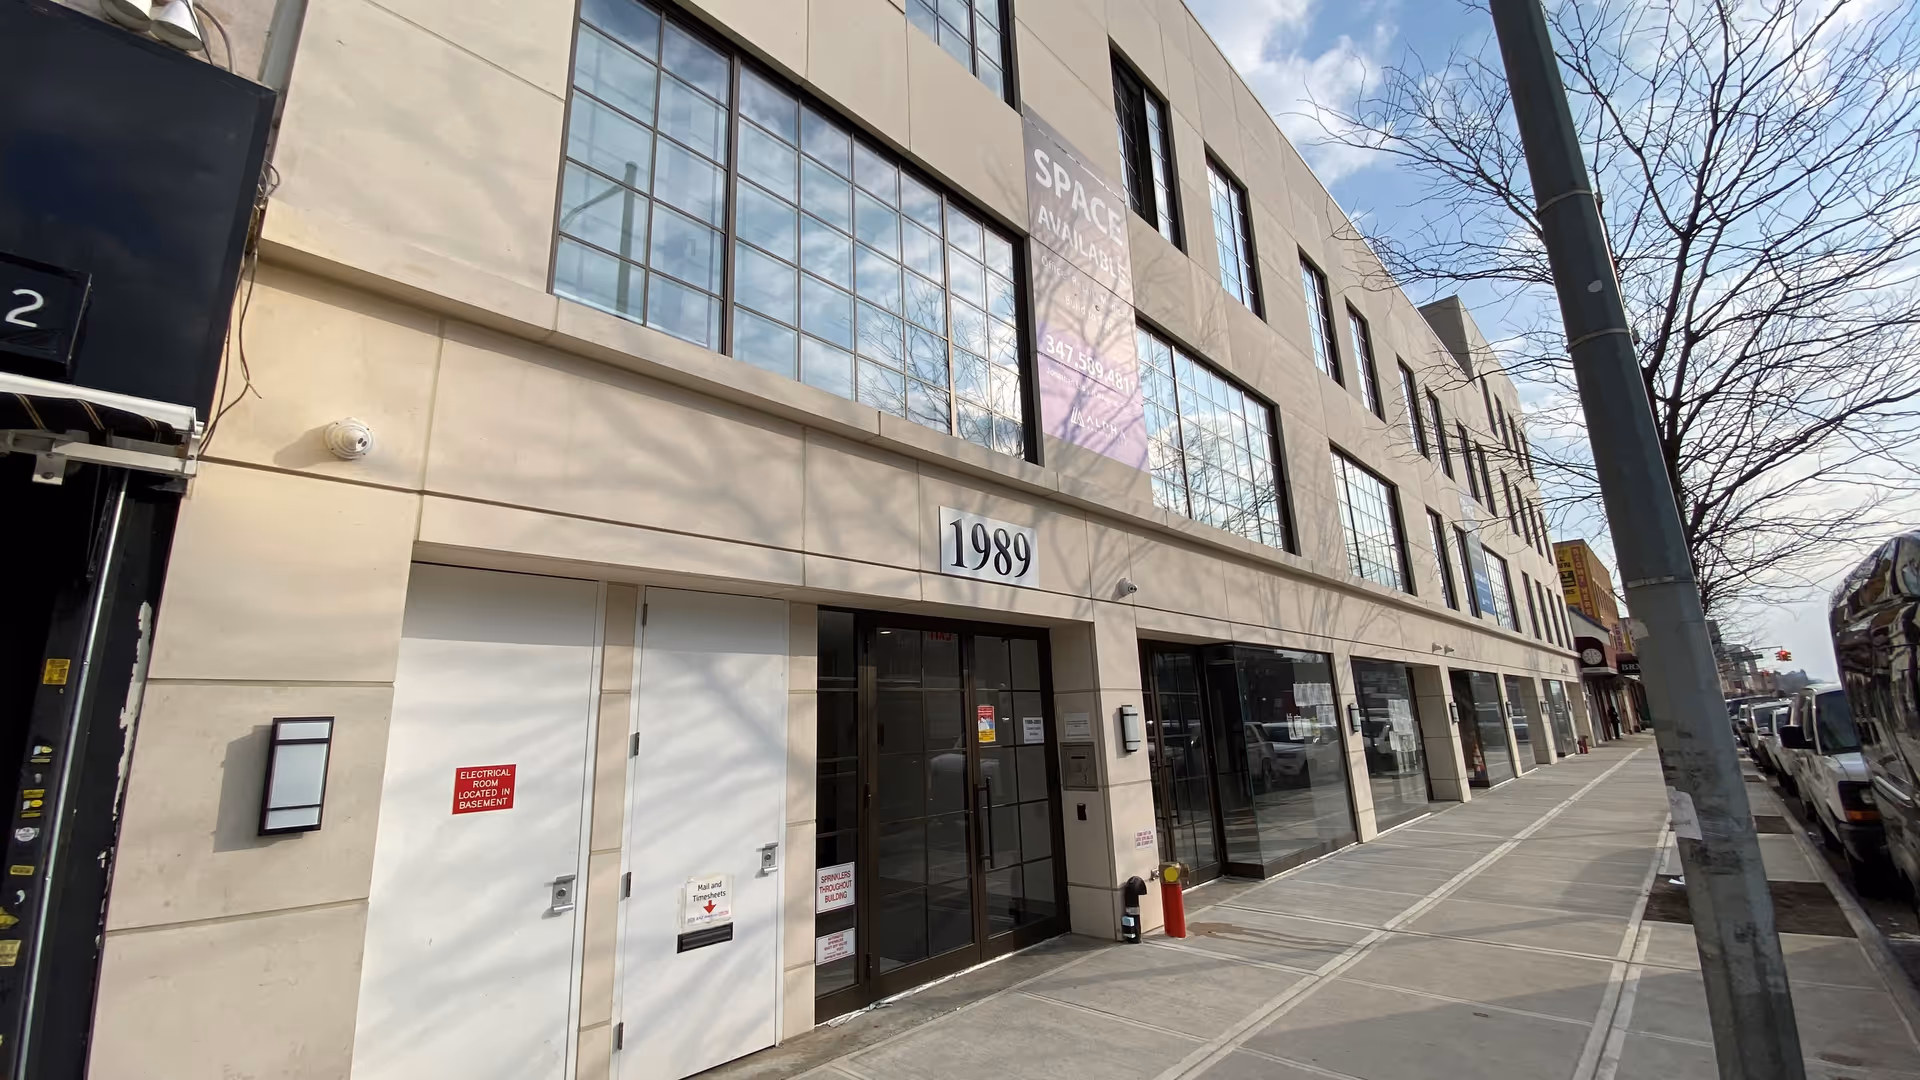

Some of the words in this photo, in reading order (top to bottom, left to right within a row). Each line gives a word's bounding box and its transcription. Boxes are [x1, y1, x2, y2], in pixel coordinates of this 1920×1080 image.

[1034, 148, 1123, 246] SPACE
[1038, 205, 1128, 286] AVAILABLE
[5, 288, 44, 328] 2
[949, 518, 1031, 578] 1989
[460, 768, 511, 780] ELECTRICAL
[472, 779, 499, 788] ROOM
[458, 788, 498, 800] LOCATED
[501, 787, 510, 796] IN
[459, 797, 508, 810] BASEMENT
[821, 870, 851, 883] SPRINKLERS
[697, 882, 710, 891] Mail
[710, 880, 722, 889] and
[819, 880, 852, 894] THROUGHOUT
[692, 890, 726, 902] Timesheets
[824, 891, 848, 903] BUILDING
